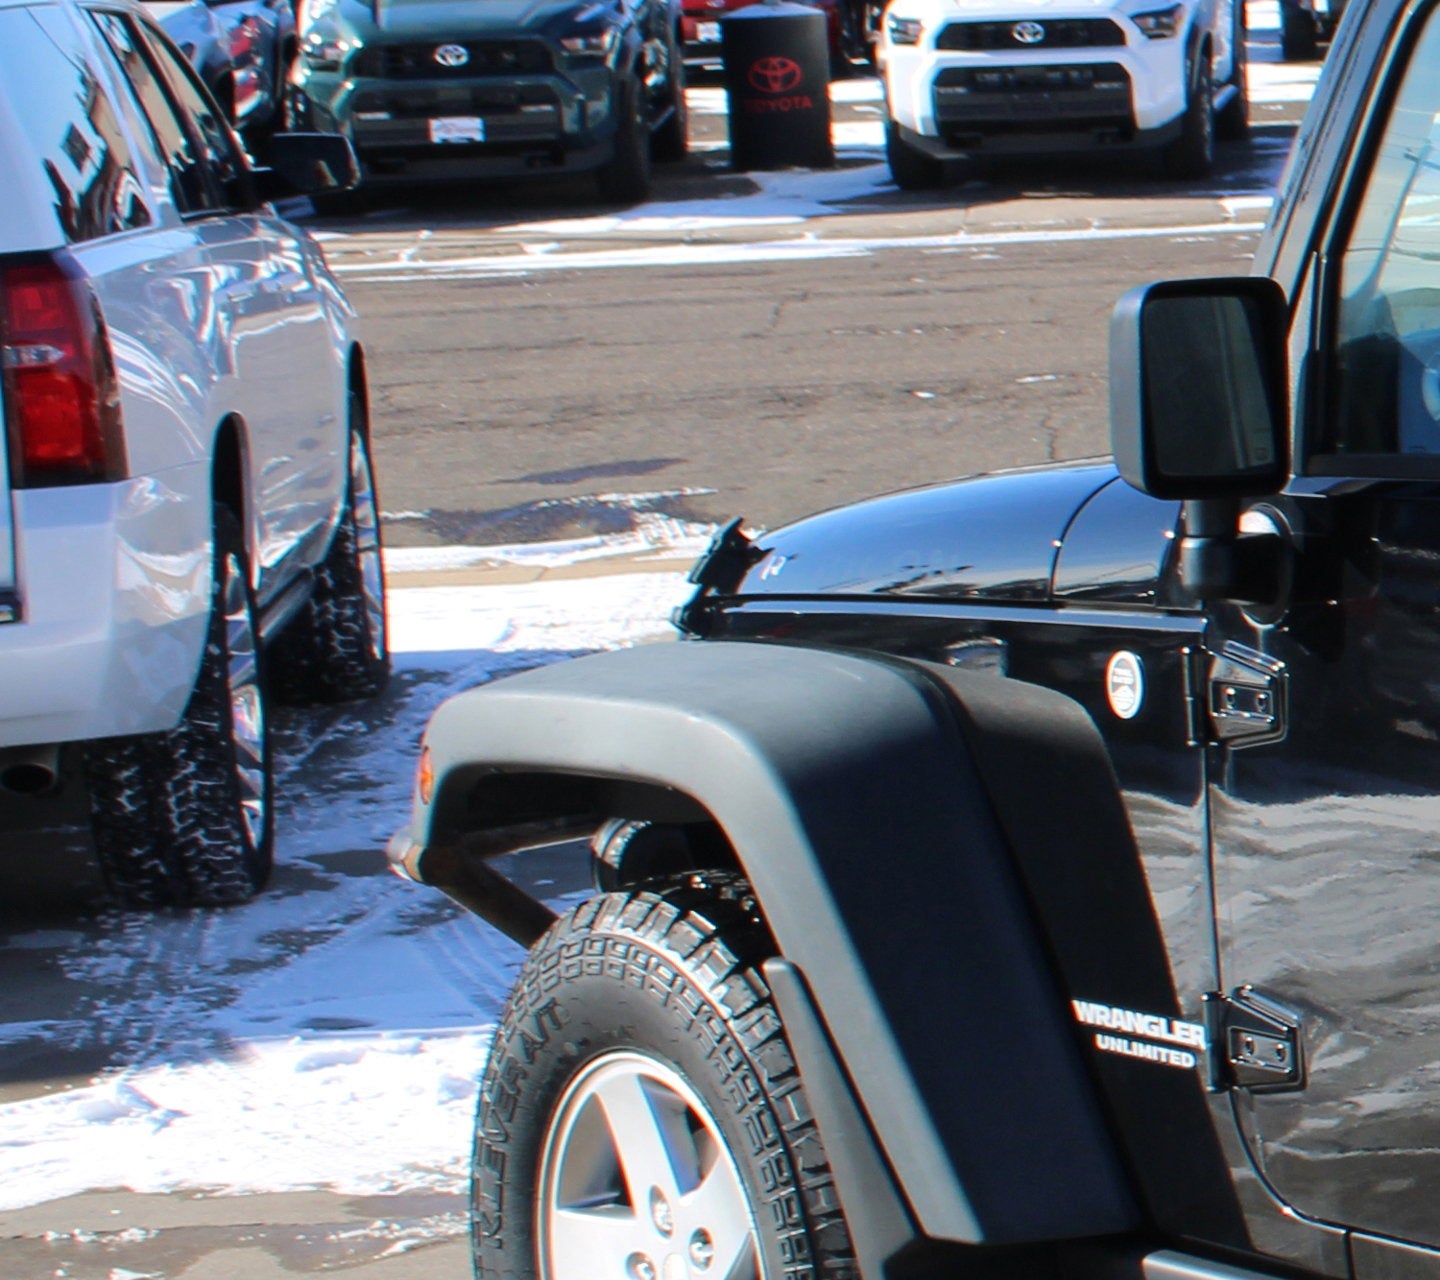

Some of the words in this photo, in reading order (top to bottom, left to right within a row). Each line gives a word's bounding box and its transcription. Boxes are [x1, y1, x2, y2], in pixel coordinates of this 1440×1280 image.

[744, 96, 813, 112] TOYOTA
[1071, 999, 1207, 1050] WRANGLER
[1094, 1033, 1197, 1069] UNLIMITED
